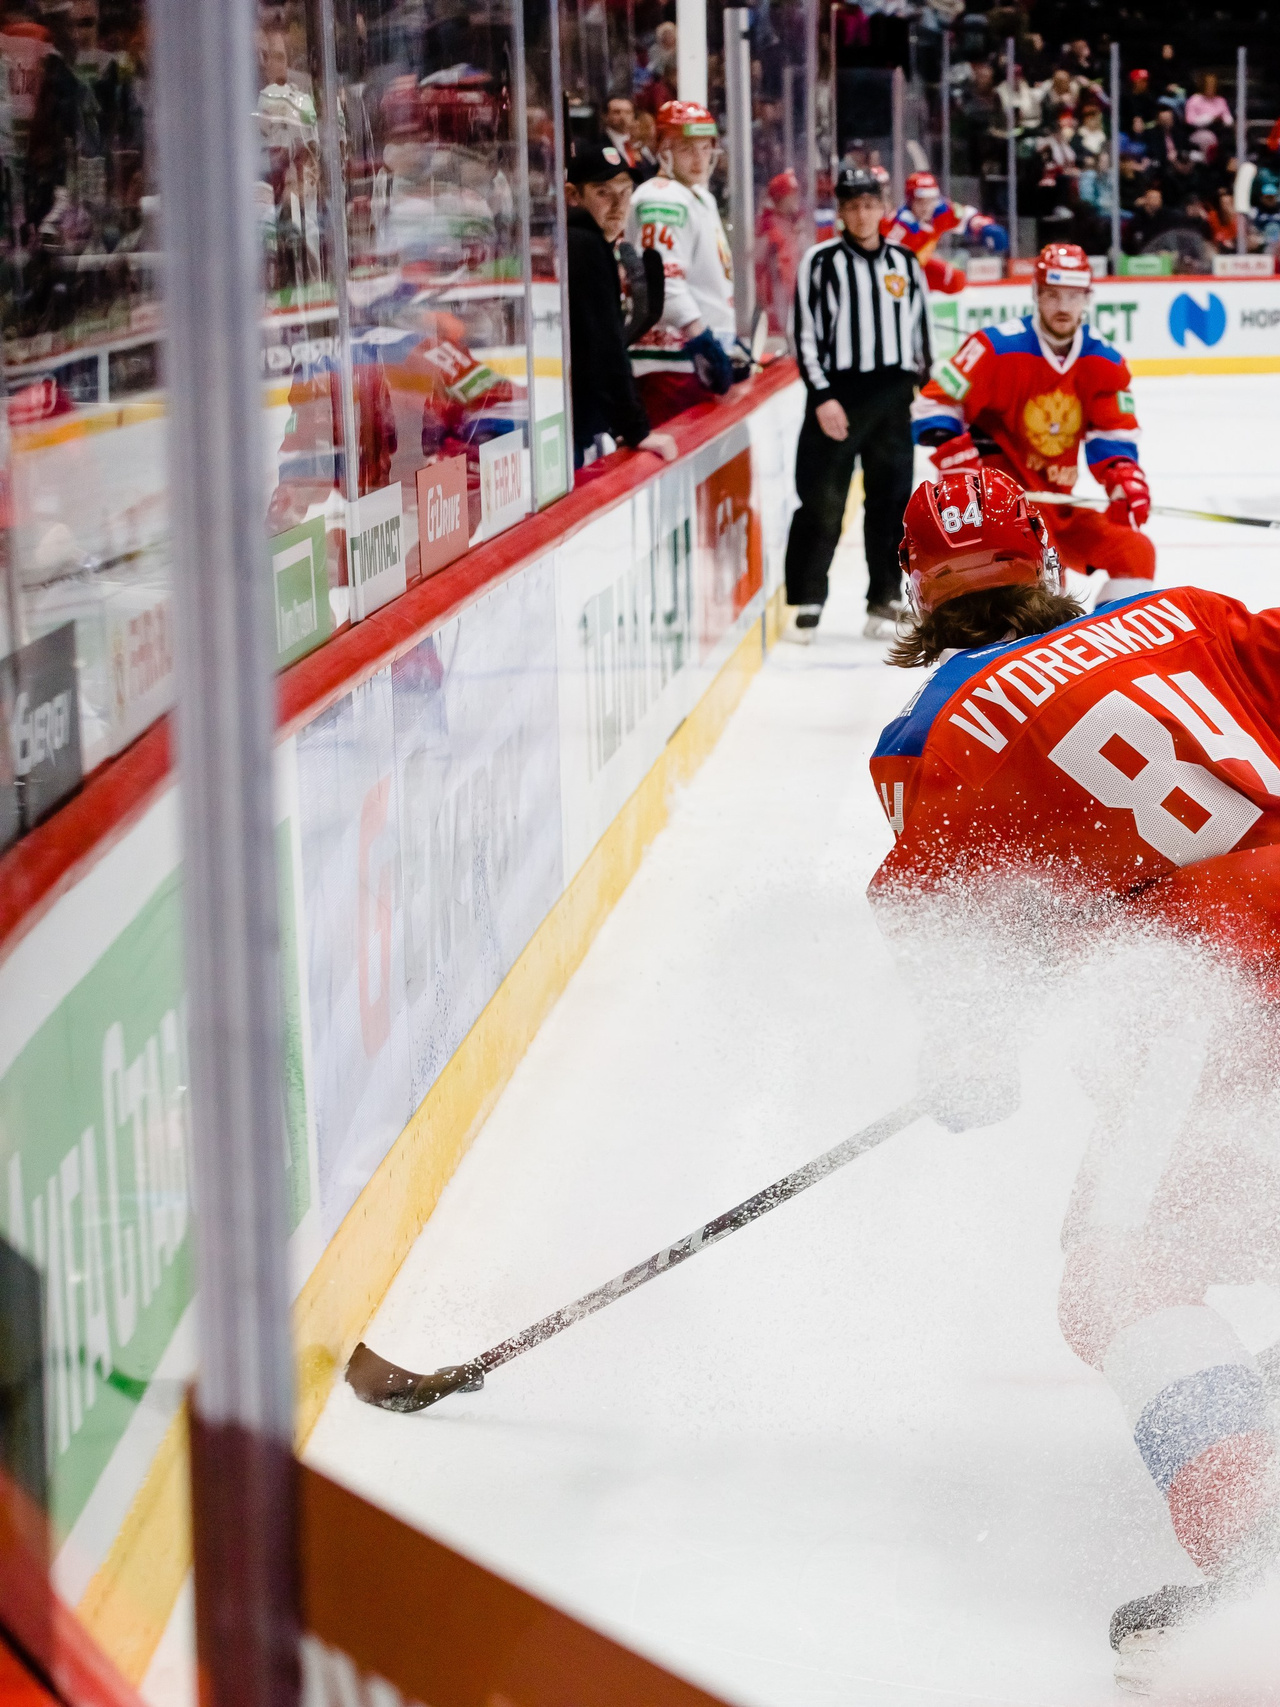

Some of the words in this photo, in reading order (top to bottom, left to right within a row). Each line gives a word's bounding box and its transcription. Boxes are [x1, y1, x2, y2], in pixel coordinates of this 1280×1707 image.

[641, 222, 674, 251] 84
[941, 501, 984, 534] 84
[948, 598, 1196, 754] VYDRENKOV
